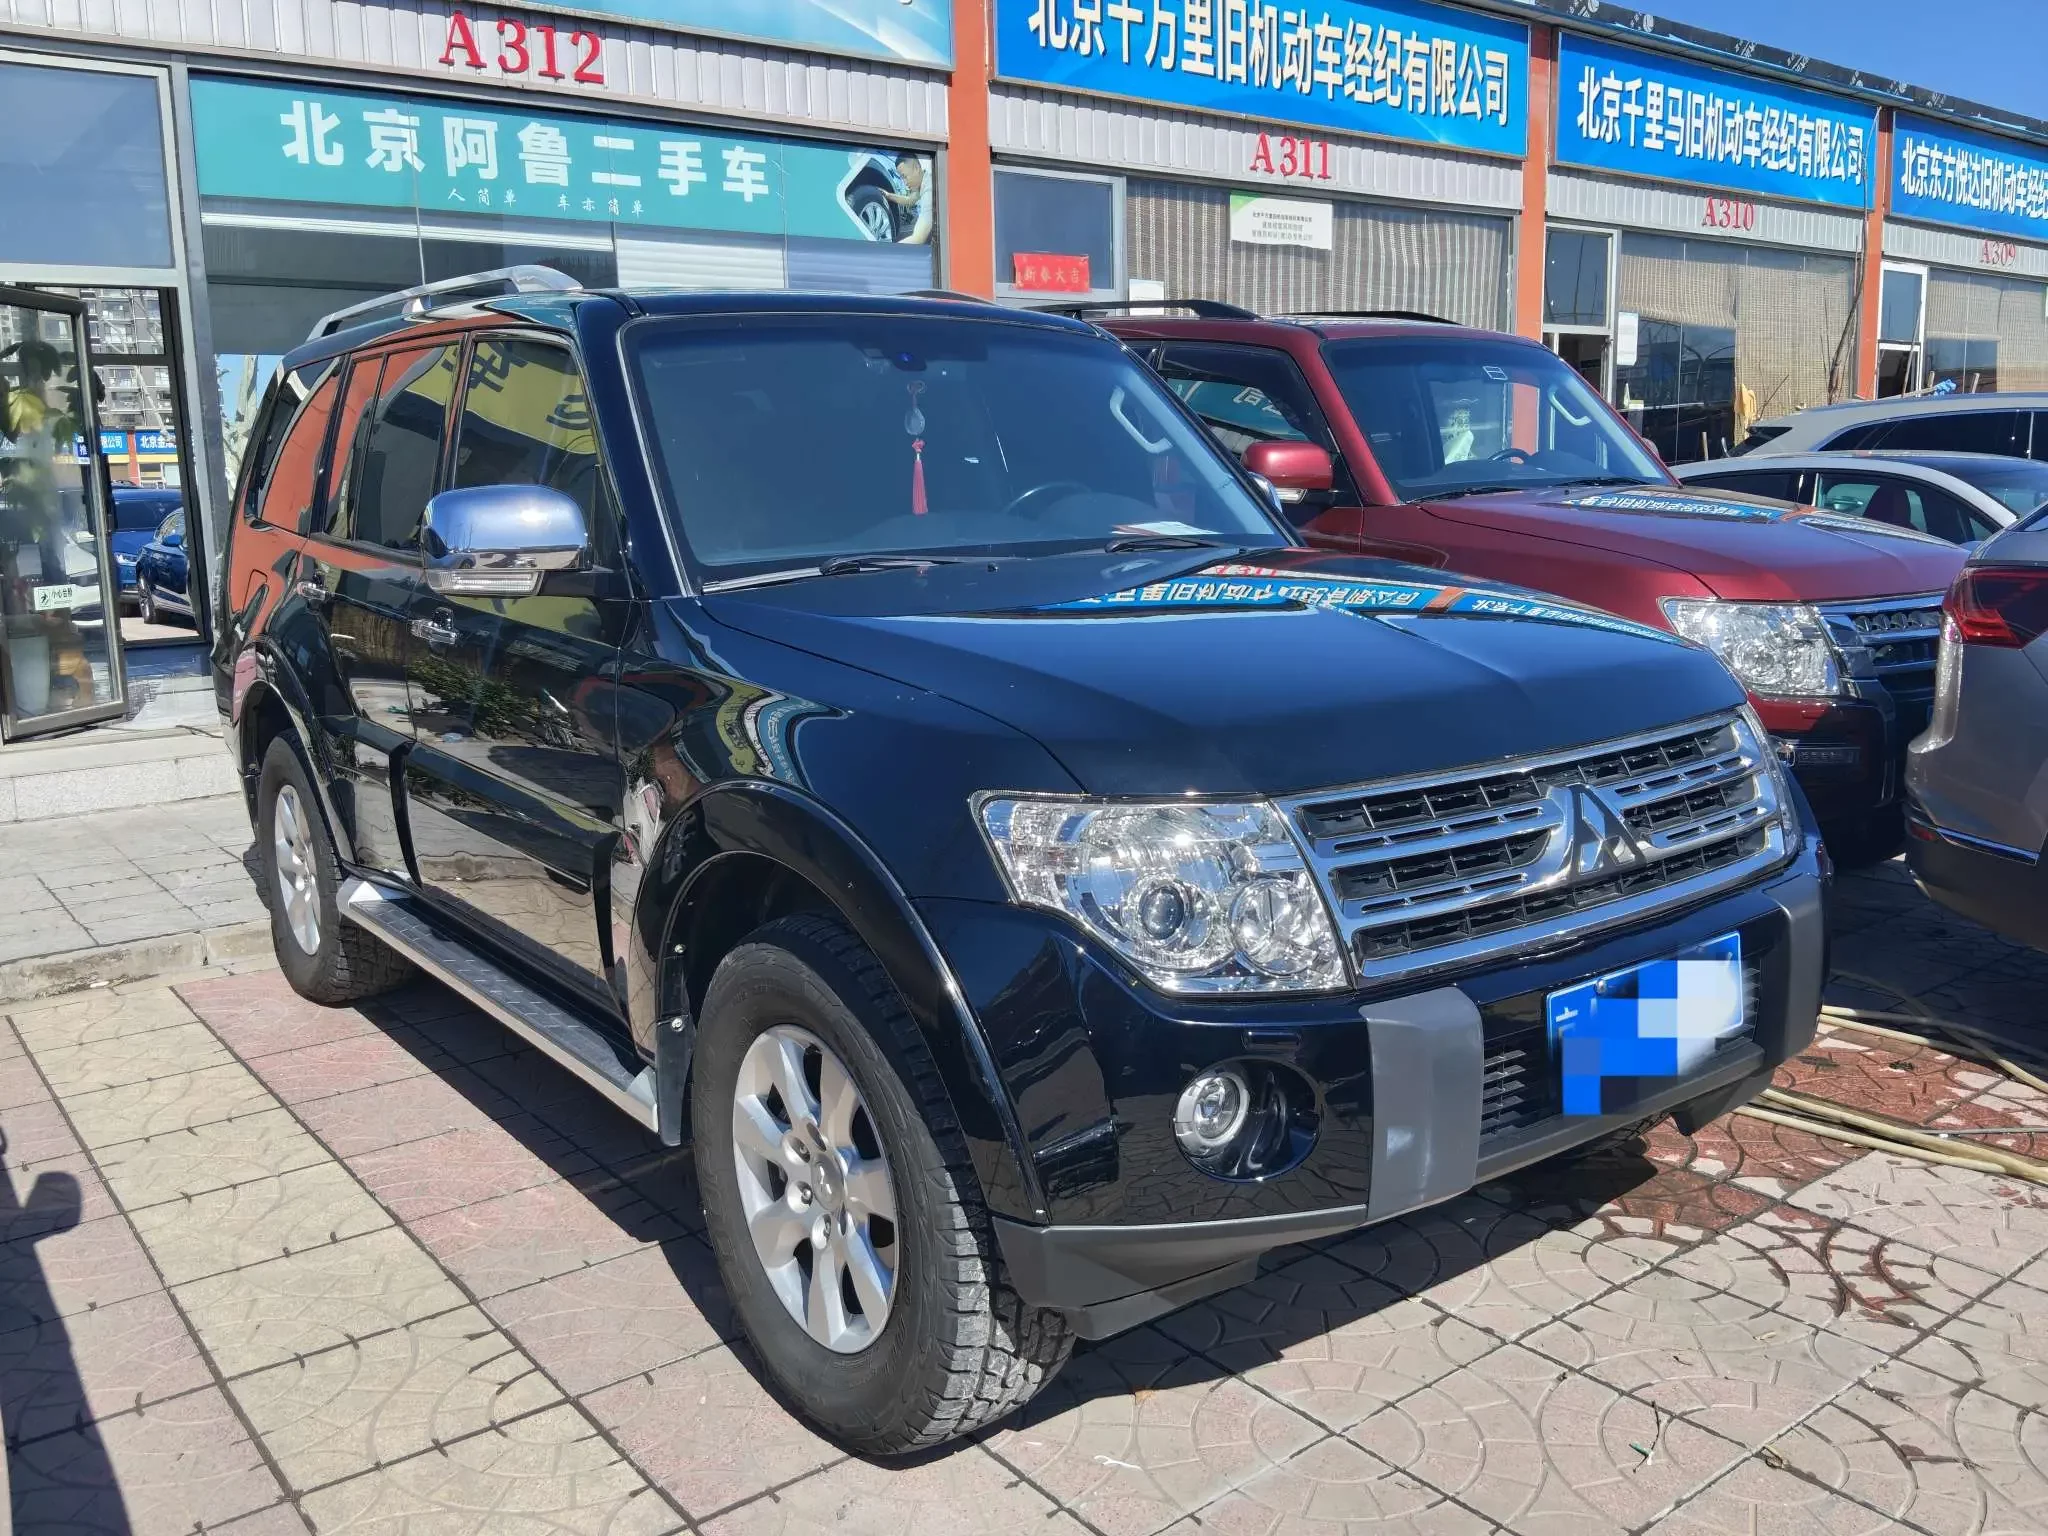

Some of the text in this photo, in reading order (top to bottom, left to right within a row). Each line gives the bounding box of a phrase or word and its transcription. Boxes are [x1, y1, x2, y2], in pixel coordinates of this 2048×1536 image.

[439, 10, 604, 85] A312
[280, 101, 769, 203] 北京阿鲁二手车
[1250, 131, 1331, 180] A311
[1577, 66, 1864, 186] 北京千里马旧机动车经纪有限公司
[1702, 195, 1754, 231] A310
[1980, 239, 2016, 266] A309
